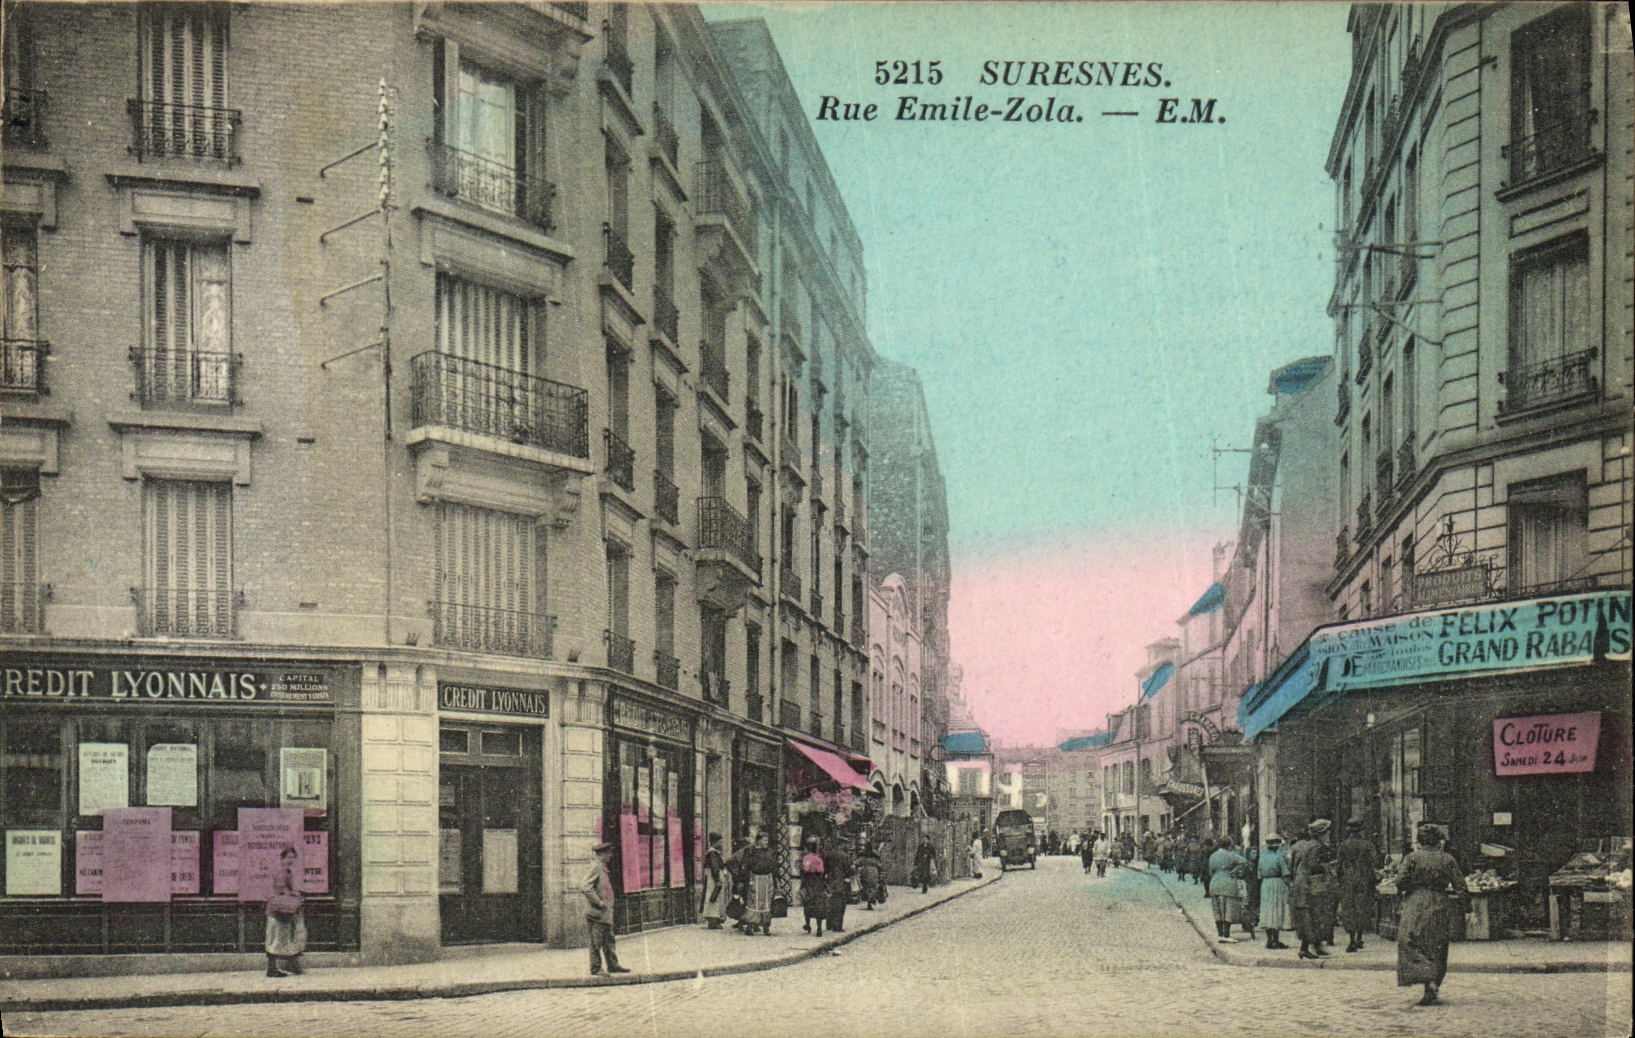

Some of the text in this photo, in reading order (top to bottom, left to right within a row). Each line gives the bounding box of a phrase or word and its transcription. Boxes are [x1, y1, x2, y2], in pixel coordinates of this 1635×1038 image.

[1418, 569, 1482, 591] PRODUITS
[1409, 615, 1433, 629] de
[1367, 629, 1434, 648] MAISON
[1438, 628, 1631, 667] GRAND RABAS
[111, 671, 258, 700] LYONNAIS
[289, 683, 329, 692] MILLIONS
[444, 686, 545, 714] CREDIT LYONNAIS
[1501, 722, 1577, 746] CLOTURE
[1543, 750, 1566, 766] 24
